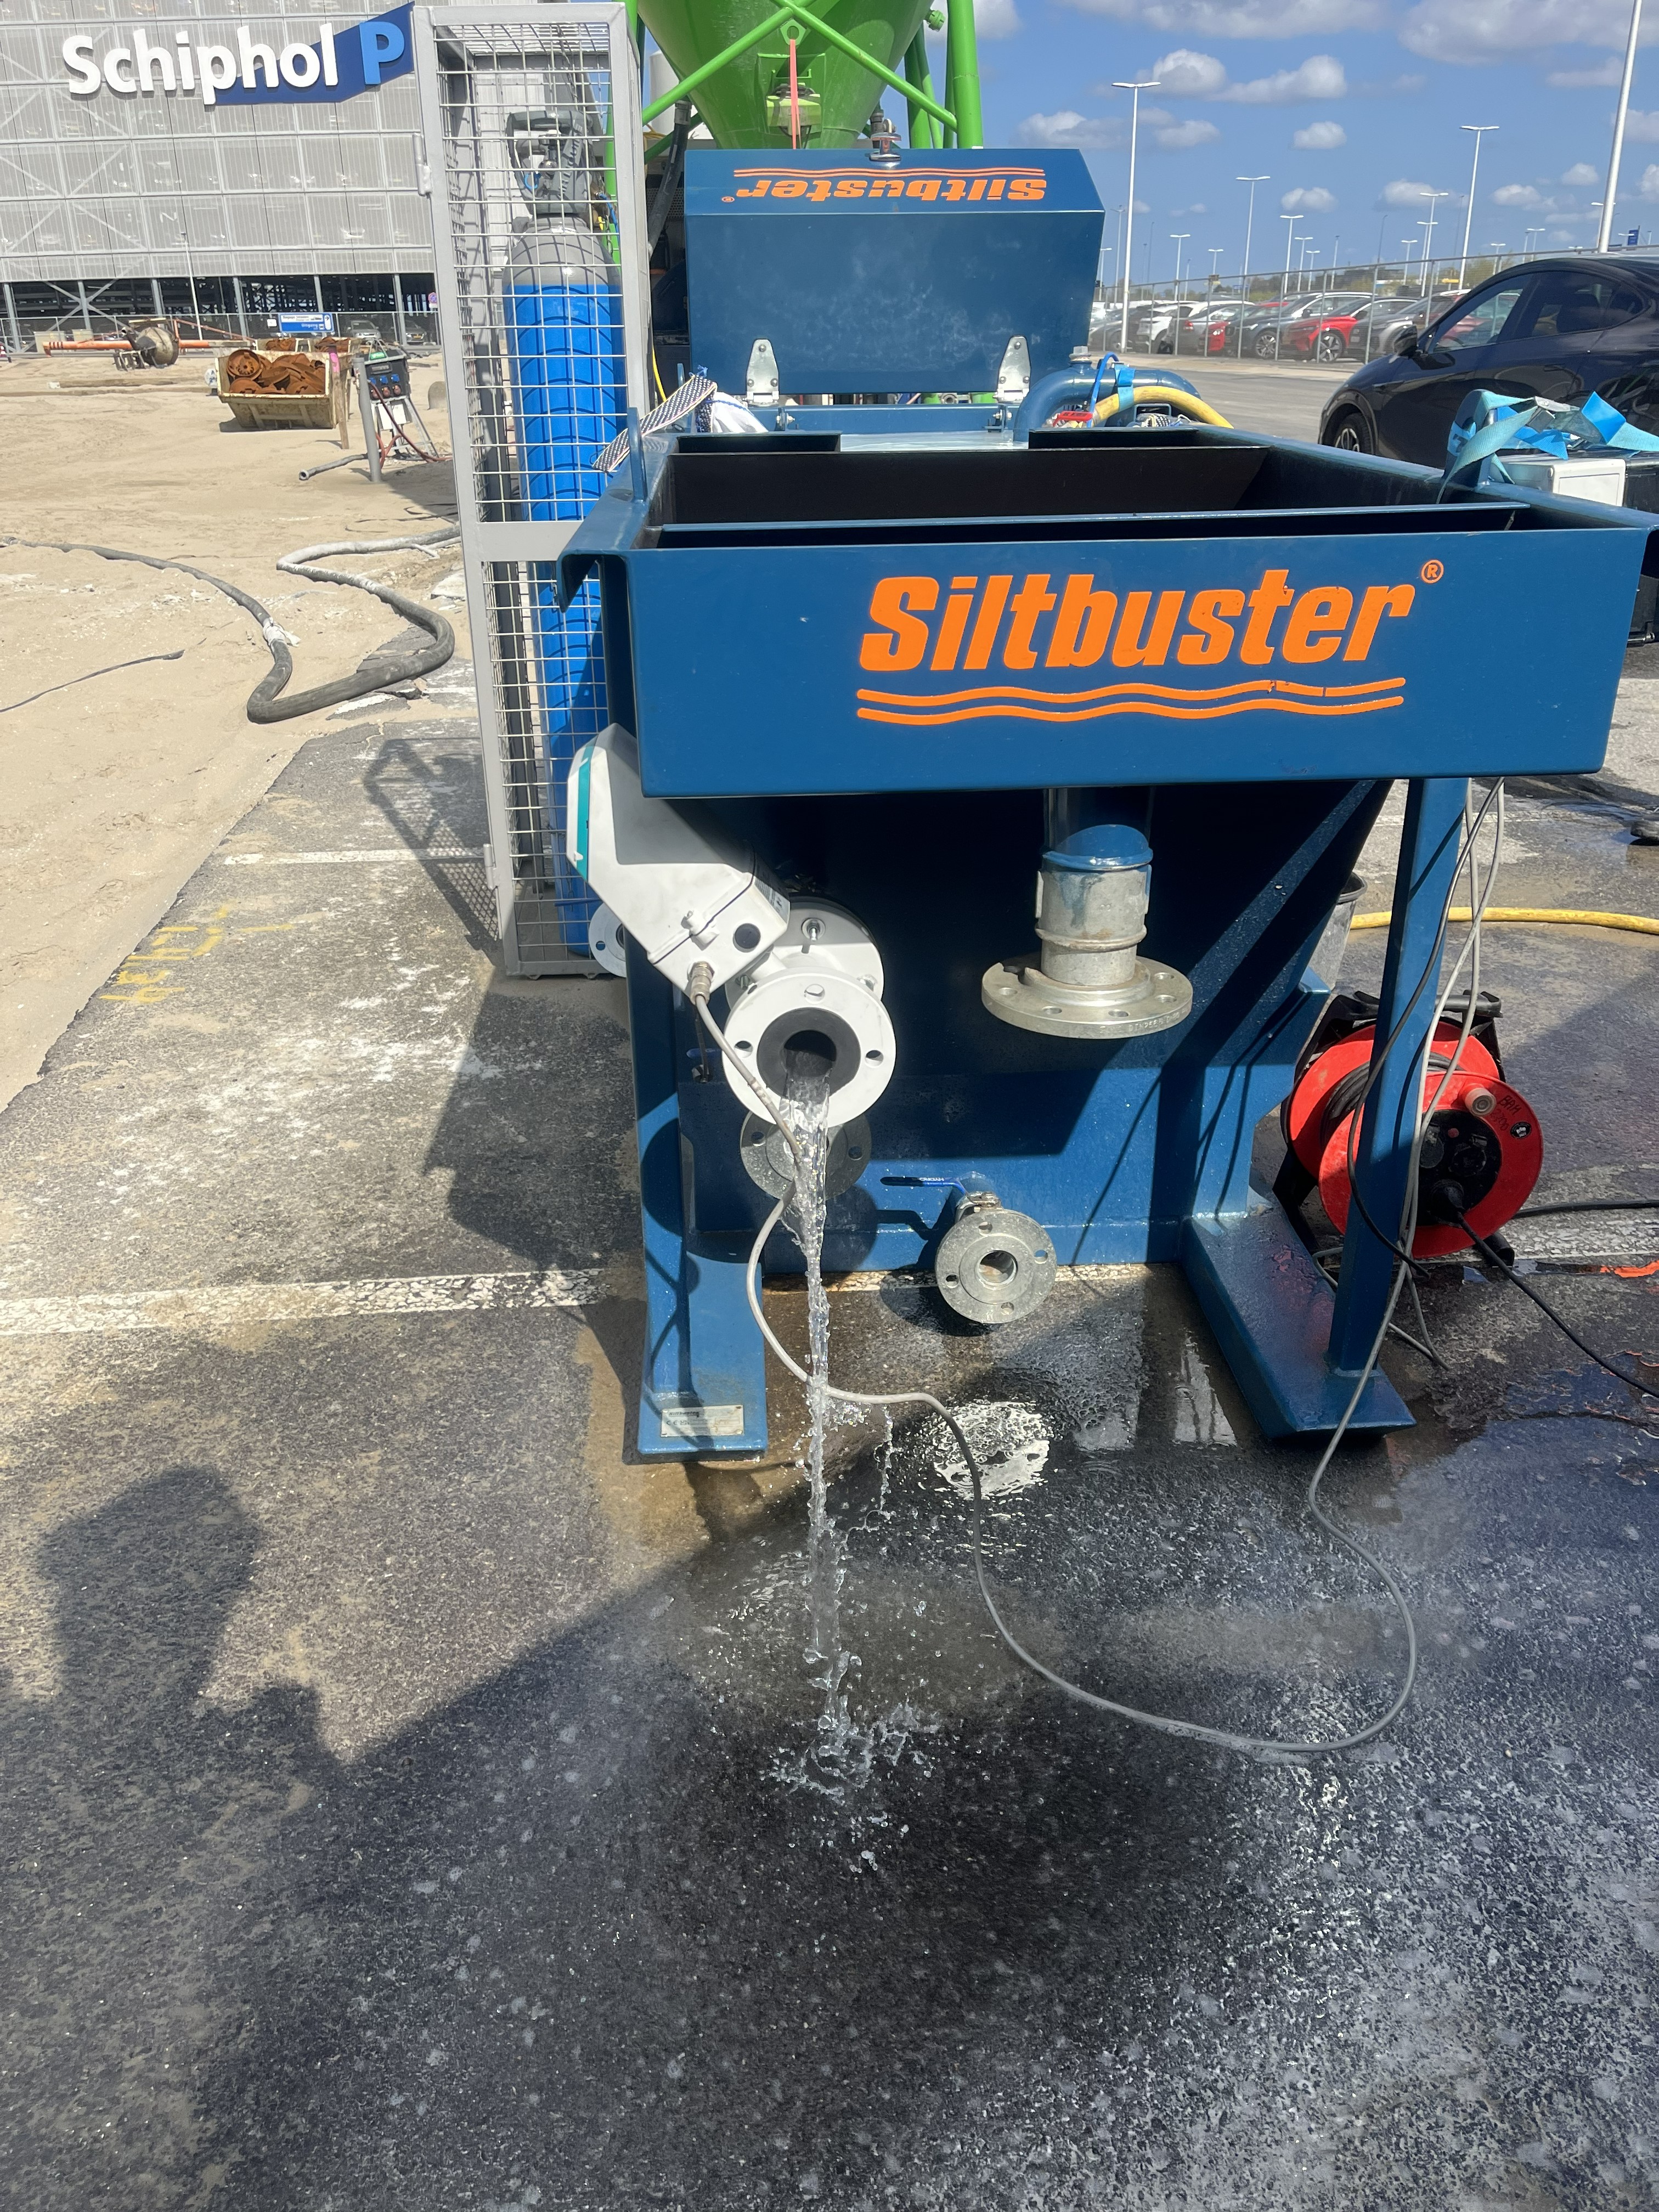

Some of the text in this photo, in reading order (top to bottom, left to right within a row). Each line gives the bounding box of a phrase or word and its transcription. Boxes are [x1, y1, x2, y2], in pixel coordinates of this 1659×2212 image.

[63, 21, 405, 105] Schiphol P
[735, 178, 1047, 201] Siltbuster
[858, 569, 1416, 672] Siltbuster
